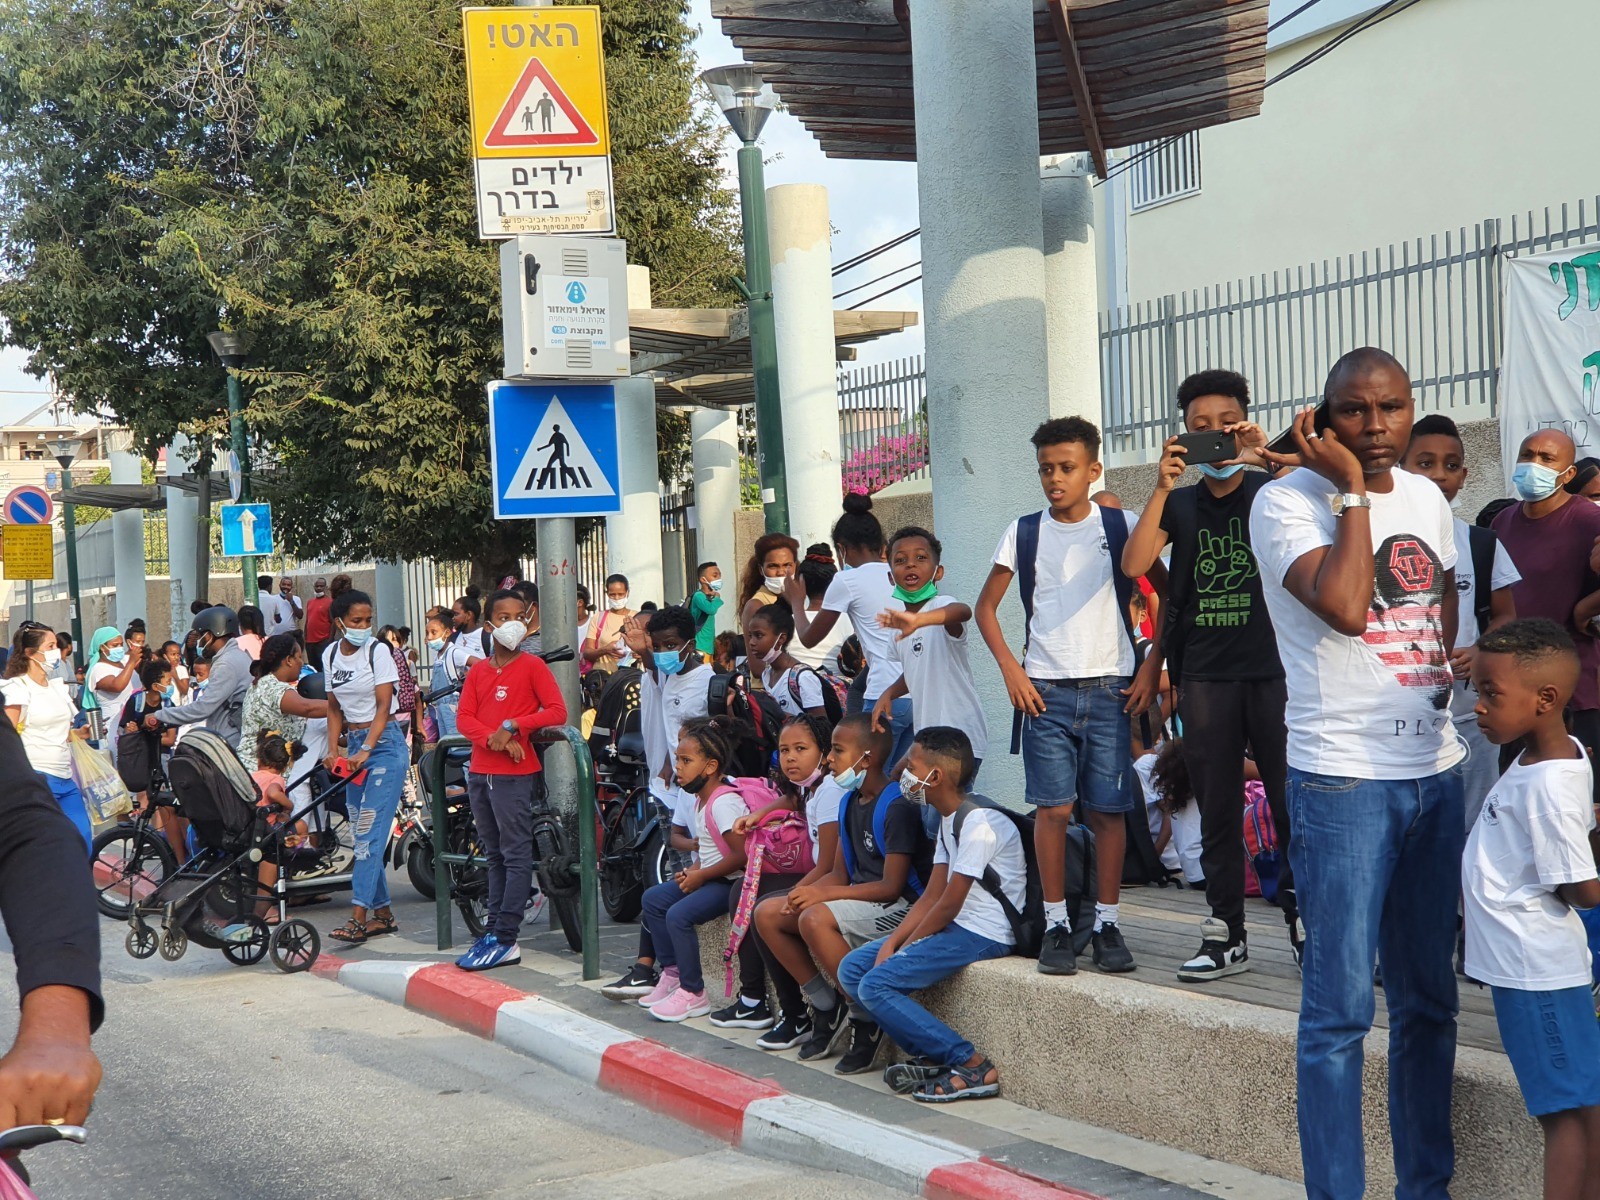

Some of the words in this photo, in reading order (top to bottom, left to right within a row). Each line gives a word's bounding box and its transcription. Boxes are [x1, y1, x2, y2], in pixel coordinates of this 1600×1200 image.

[487, 22, 579, 48] האט!
[511, 160, 583, 186] ילדים
[487, 190, 560, 216] בדרך
[580, 305, 606, 315] אריאל
[569, 327, 603, 336] מקבוצת
[1199, 593, 1251, 612] PRESS
[1195, 611, 1251, 627] START
